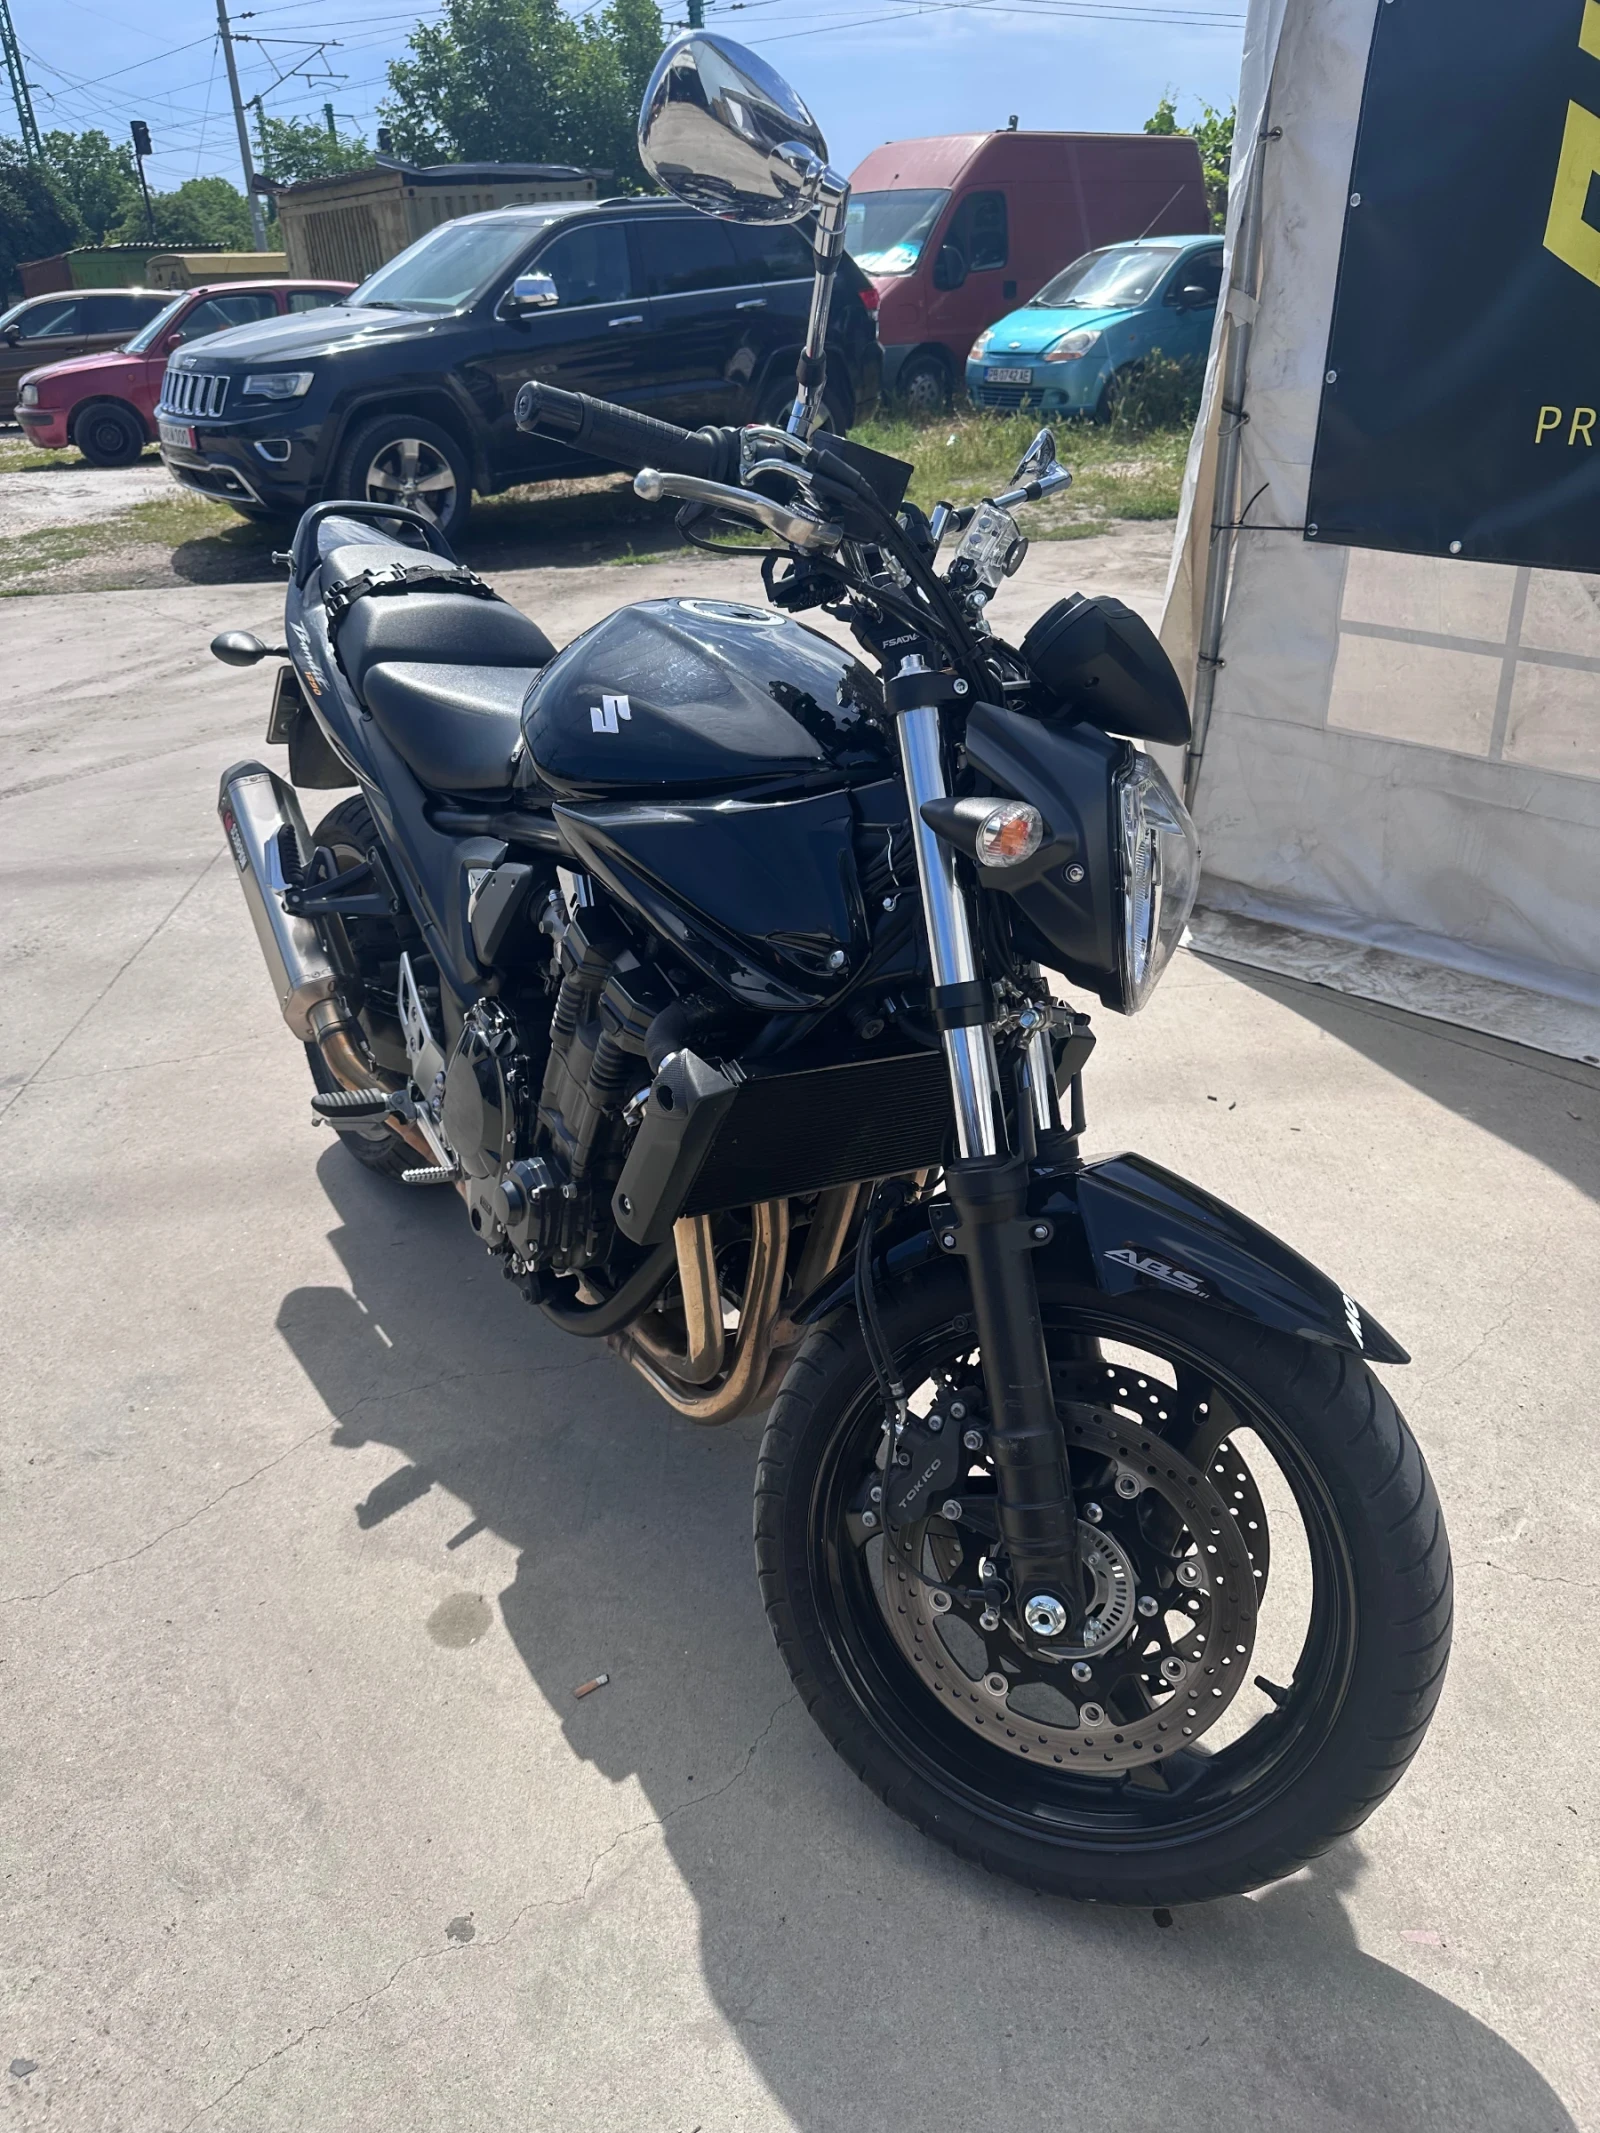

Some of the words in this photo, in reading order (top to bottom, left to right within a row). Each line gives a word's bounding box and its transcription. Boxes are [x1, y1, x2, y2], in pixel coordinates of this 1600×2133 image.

[1534, 405, 1597, 446] PR
[1103, 1249, 1204, 1290] ABS
[898, 1458, 941, 1508] TOKICO
